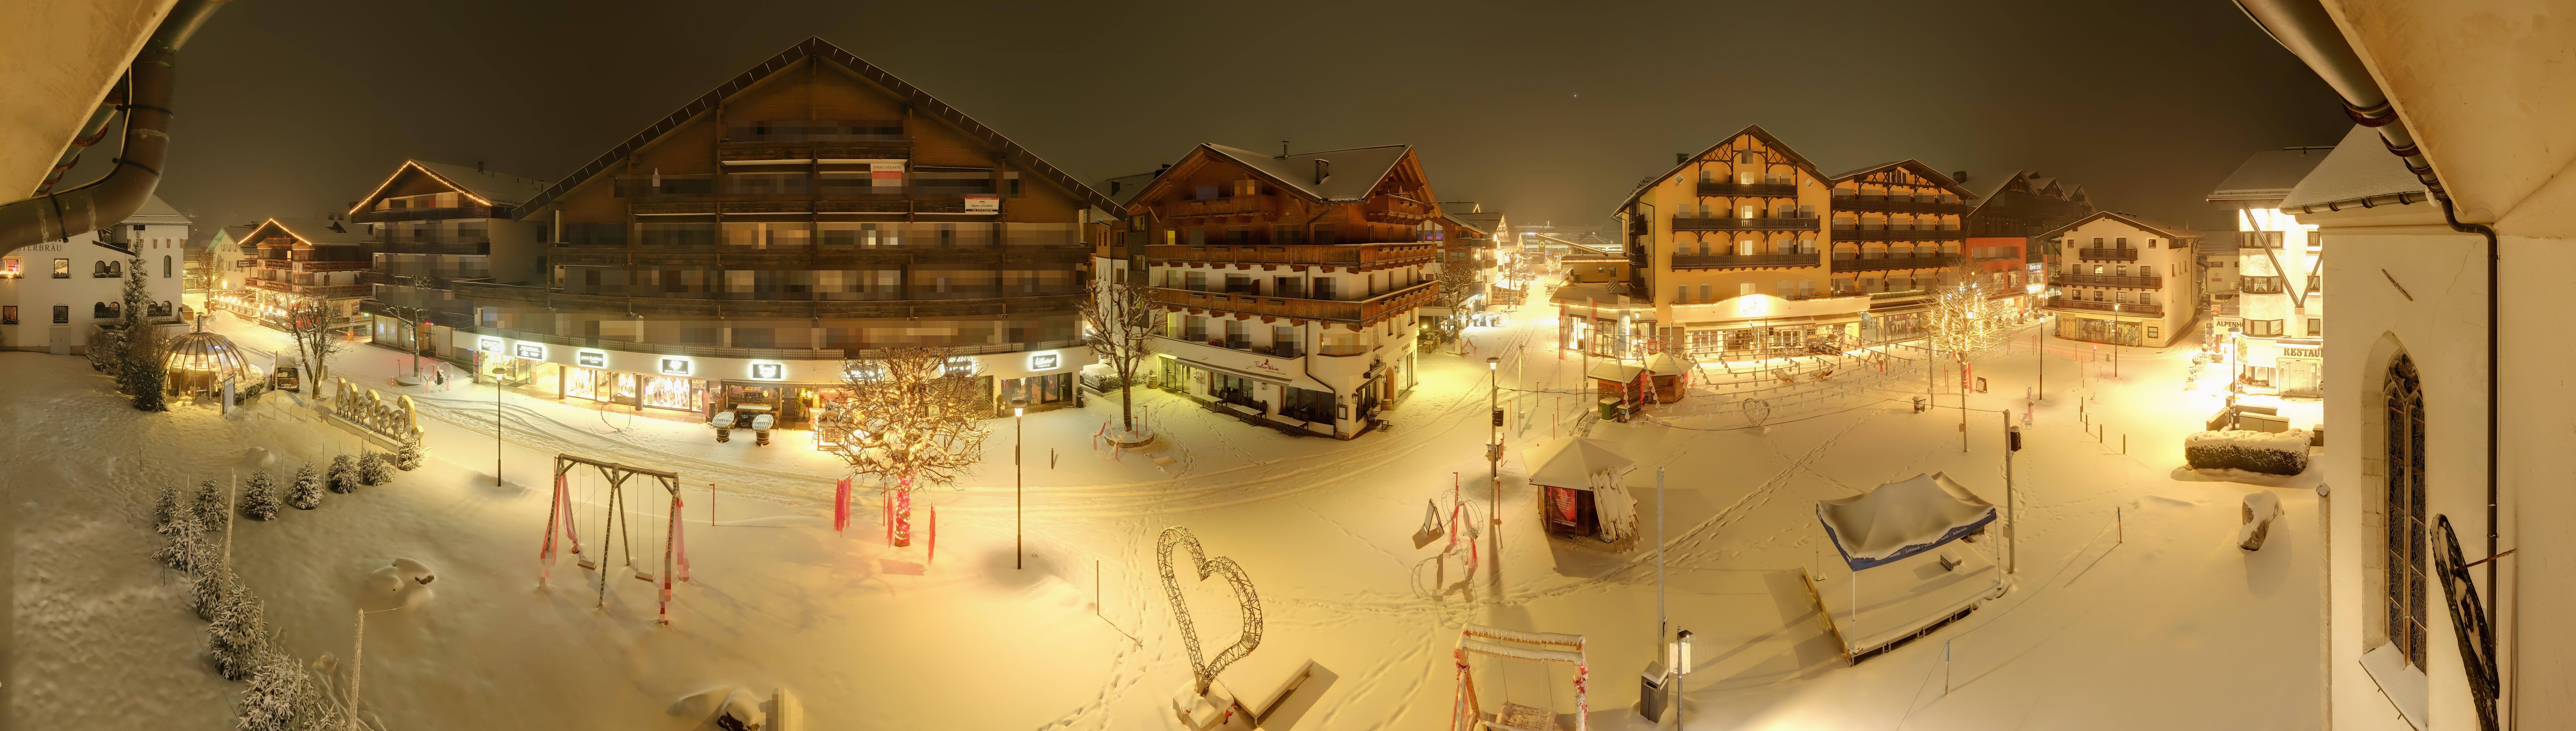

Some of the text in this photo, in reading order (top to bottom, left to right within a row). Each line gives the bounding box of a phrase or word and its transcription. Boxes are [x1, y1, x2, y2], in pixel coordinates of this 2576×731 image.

[1402, 343, 1410, 351] SAILER
[1371, 364, 1385, 377] RESTAURANT
[1953, 526, 1967, 535] Scharnitz
